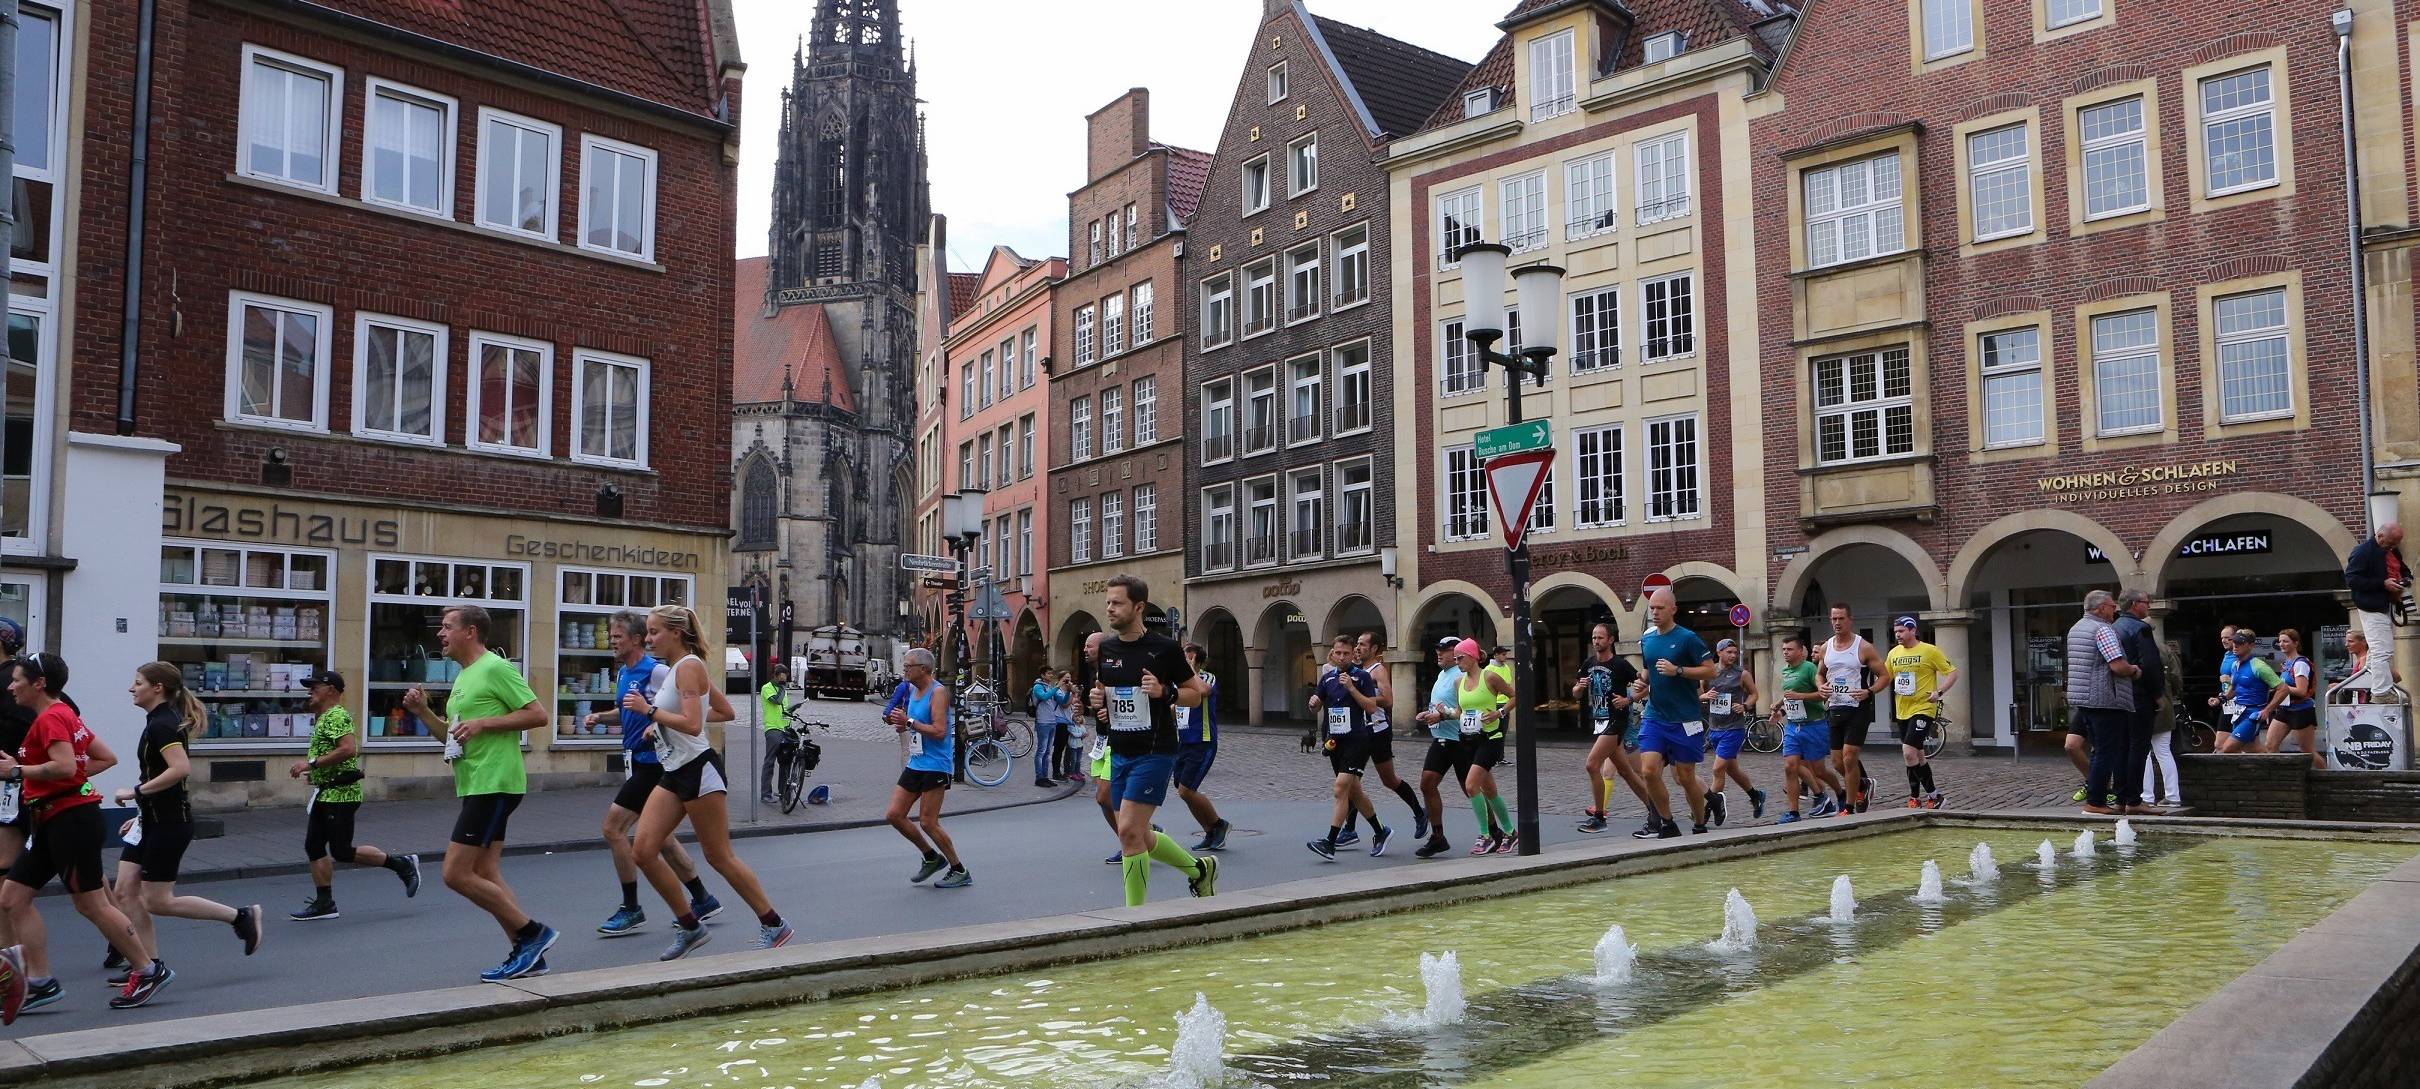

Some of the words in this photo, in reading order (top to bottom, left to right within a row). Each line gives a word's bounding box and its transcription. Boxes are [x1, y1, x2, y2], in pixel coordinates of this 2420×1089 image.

[1477, 433, 1491, 444] Hotel
[1478, 445, 1497, 456] Busche
[1498, 443, 1507, 453] am
[1508, 440, 1521, 450] Dom
[2038, 472, 2116, 492] WOHNEN
[2118, 466, 2139, 486] &
[2141, 460, 2237, 483] SCHLAFEN
[2055, 487, 2158, 503] INDIVIDUELLES
[2165, 481, 2217, 494] DESIGN
[163, 494, 399, 547] Glashaus
[506, 534, 698, 568] Geschenkideen
[1585, 545, 1629, 562] Boch
[1082, 580, 1108, 595] SHOE
[1112, 699, 1135, 713] 785
[1463, 717, 1476, 727] 271
[2363, 741, 2392, 749] FRIDAY
